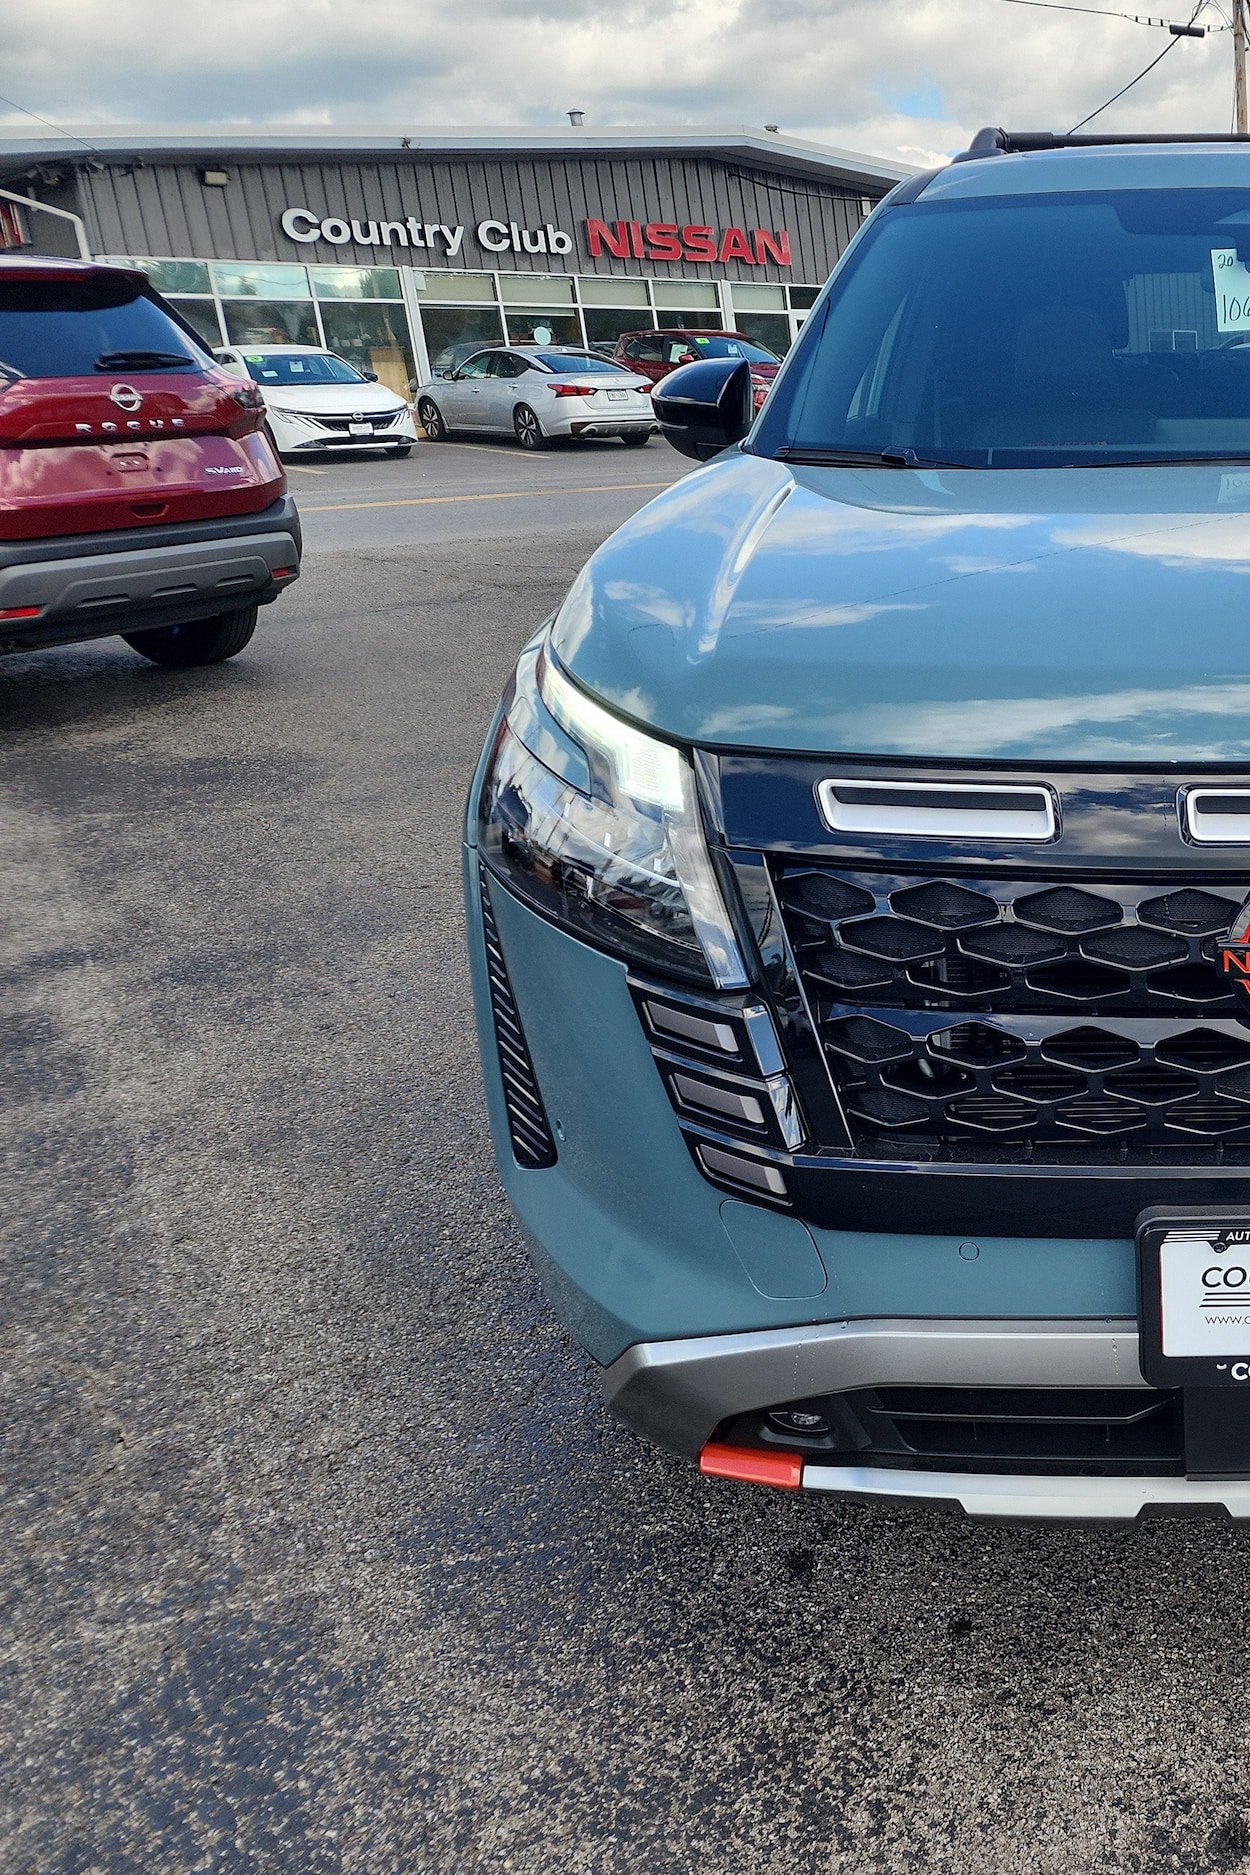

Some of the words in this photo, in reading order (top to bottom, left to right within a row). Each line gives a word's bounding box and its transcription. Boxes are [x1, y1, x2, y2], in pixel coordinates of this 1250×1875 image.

[281, 207, 463, 256] Country
[477, 219, 572, 255] Club
[585, 218, 792, 266] NISSAN
[75, 418, 185, 432] ROGUE
